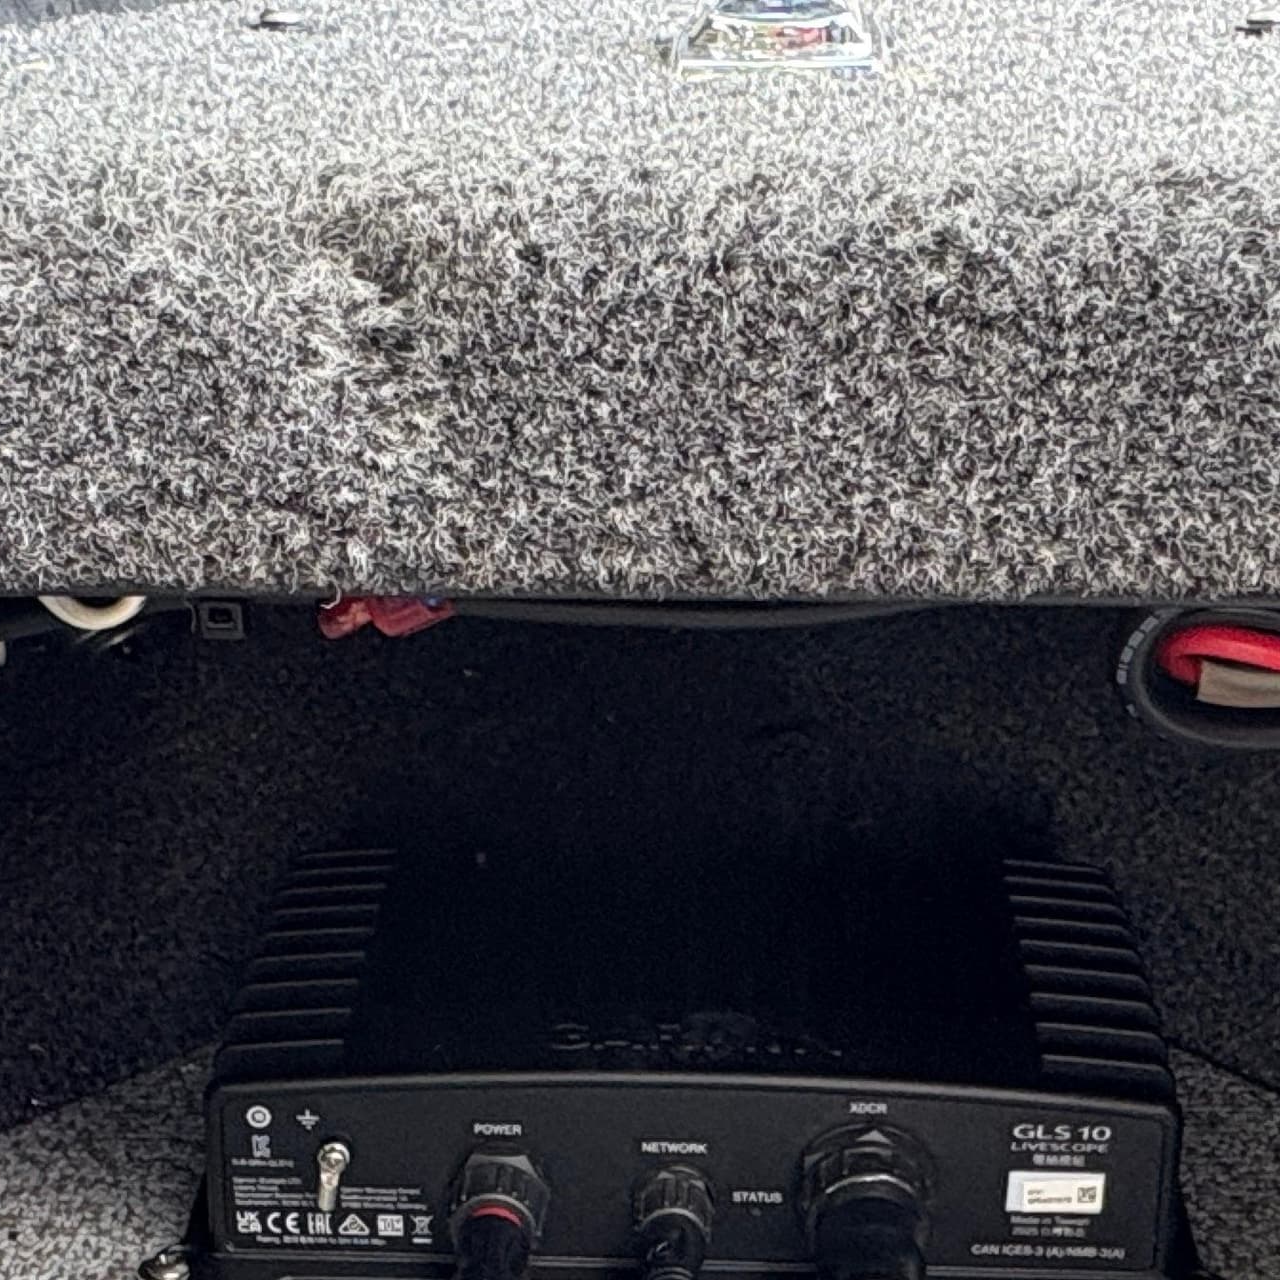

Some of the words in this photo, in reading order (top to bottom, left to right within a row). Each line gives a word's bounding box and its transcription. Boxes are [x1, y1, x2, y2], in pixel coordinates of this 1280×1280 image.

[473, 1123, 522, 1136] POWER
[1012, 1123, 1072, 1141] GLS
[1077, 1125, 1113, 1142] 10
[641, 1141, 708, 1155] NETWORK
[1010, 1141, 1110, 1154] LIVESCOPE
[732, 1191, 783, 1204] STATUS
[970, 1244, 1000, 1256] CAN
